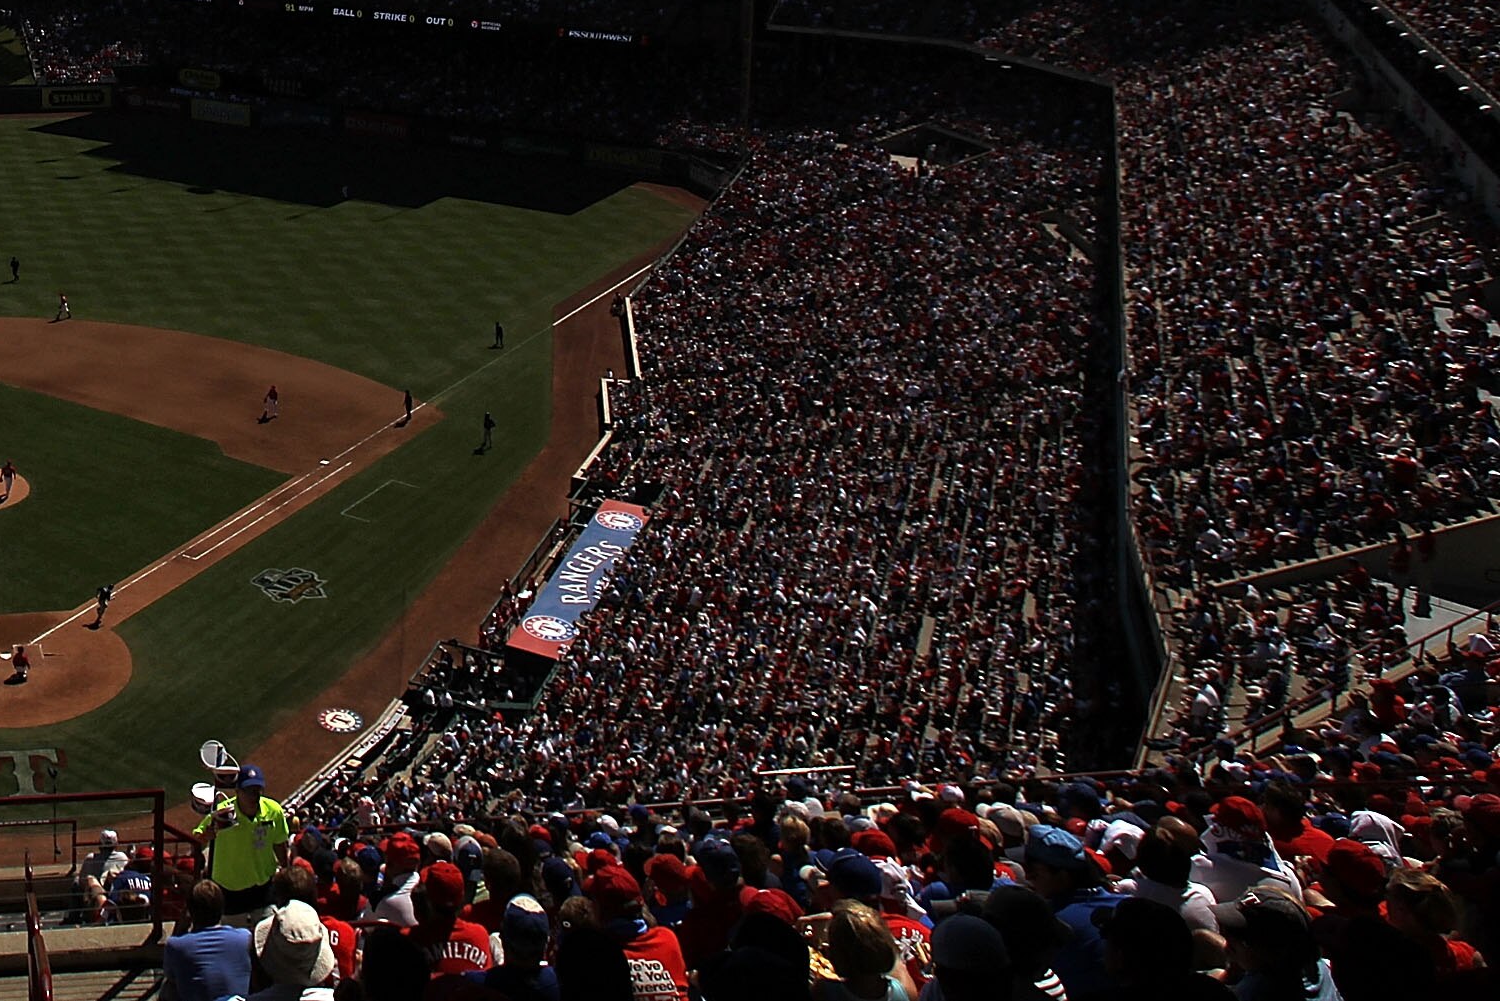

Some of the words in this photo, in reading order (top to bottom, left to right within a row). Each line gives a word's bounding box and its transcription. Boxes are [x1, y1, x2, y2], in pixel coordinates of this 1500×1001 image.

[285, 3, 296, 12] 91
[332, 8, 355, 17] BALL
[356, 10, 362, 18] 0
[373, 11, 407, 22] STRIKE
[409, 14, 415, 23] 0
[426, 17, 446, 26] OUT
[448, 18, 454, 27] 0
[51, 93, 101, 105] STANLEY
[558, 540, 624, 605] RANGERS
[426, 941, 488, 969] AMILTON
[629, 972, 643, 982] ot
[645, 971, 670, 981] You
